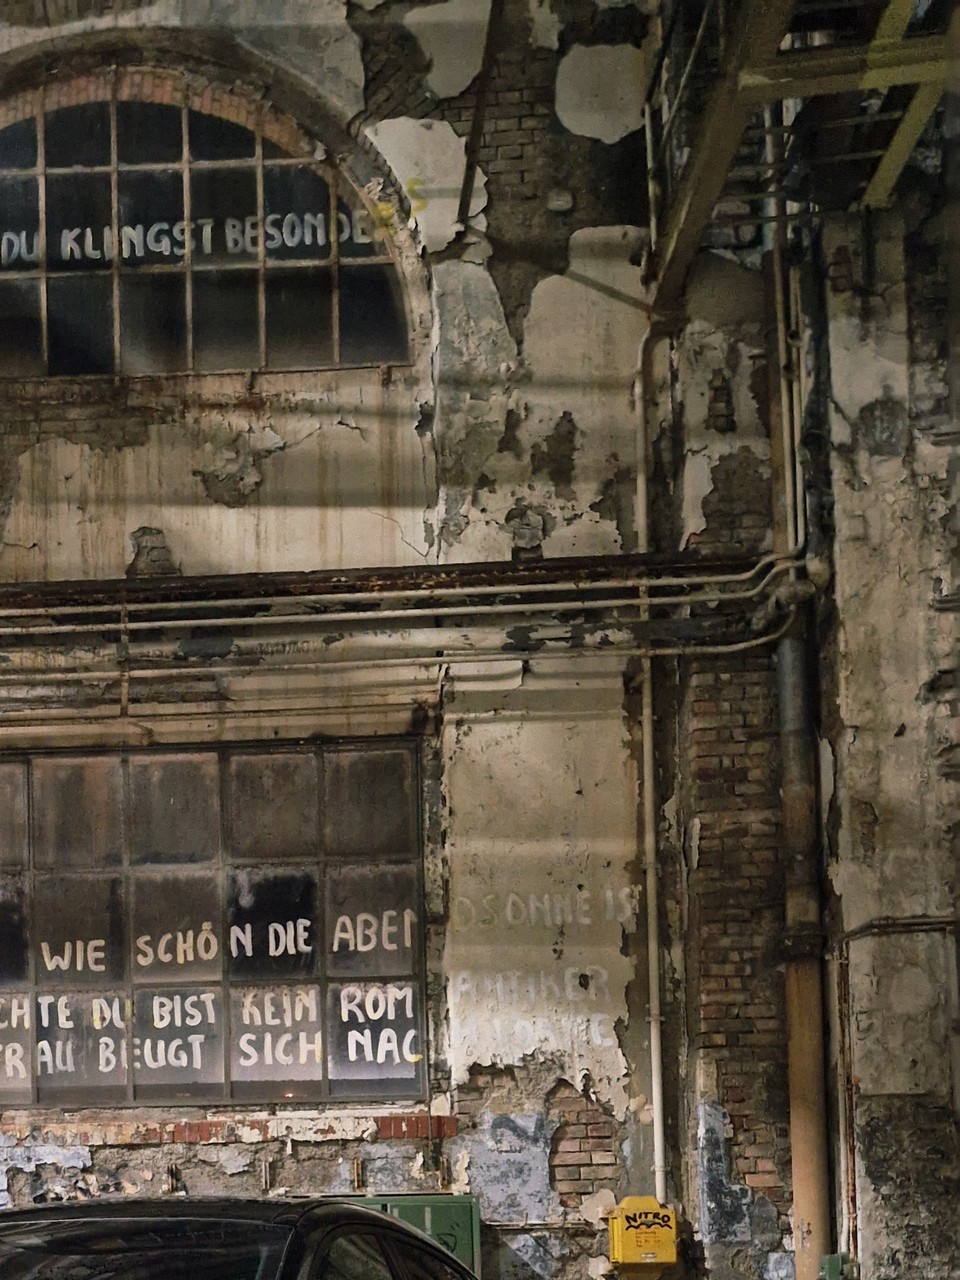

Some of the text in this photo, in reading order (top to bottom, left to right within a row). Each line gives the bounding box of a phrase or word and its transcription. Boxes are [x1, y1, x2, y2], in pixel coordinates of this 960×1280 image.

[0, 230, 39, 265] DU
[61, 219, 214, 261] KLINGST
[41, 939, 106, 973] WIE
[136, 922, 253, 966] SCHÖN
[267, 918, 313, 955] DIE
[152, 992, 216, 1026] BIST
[341, 986, 414, 1022] ROM
[239, 1032, 322, 1066] SICH
[625, 1211, 671, 1224] NITRO
